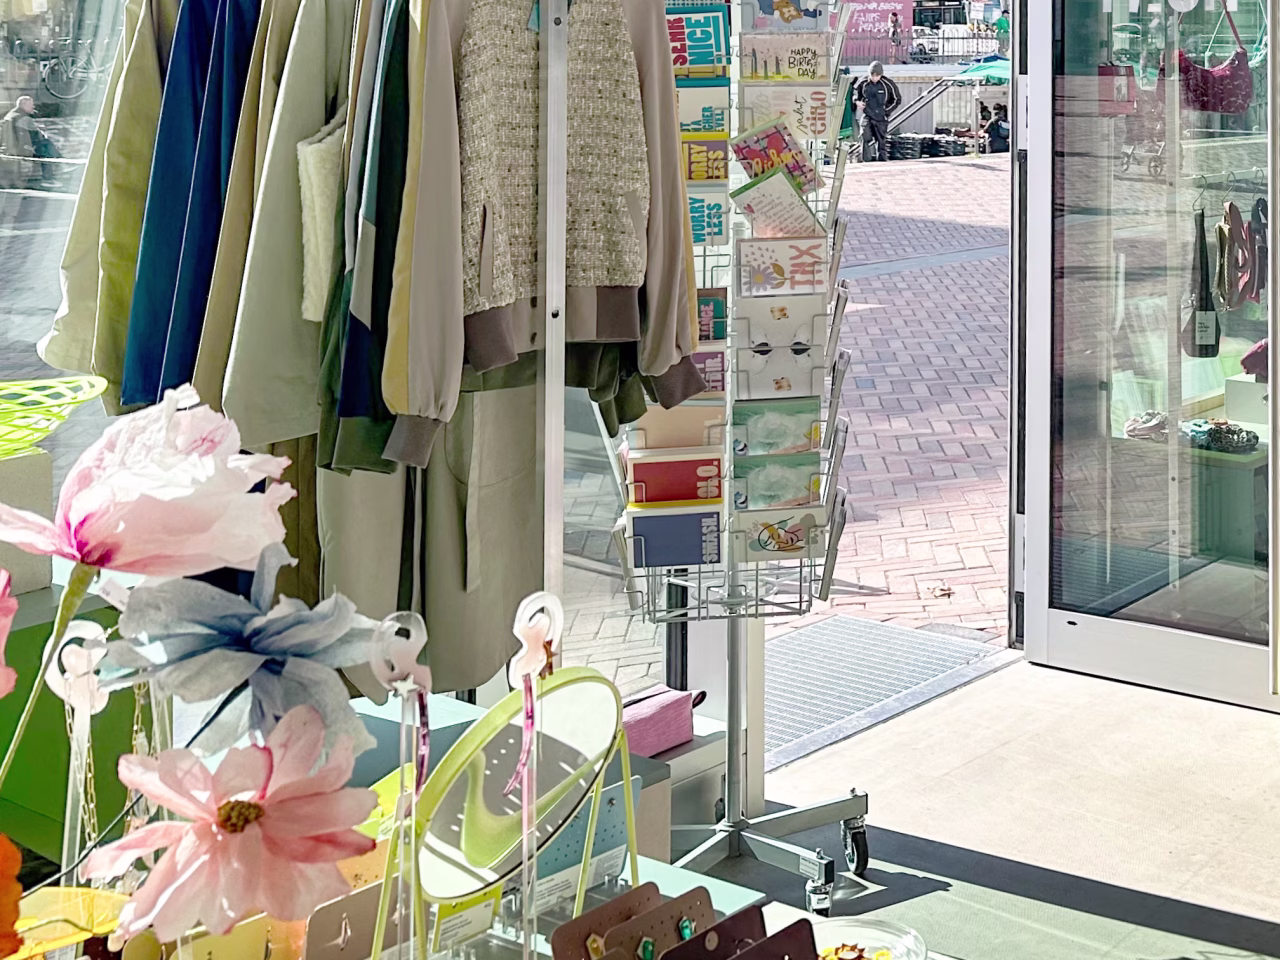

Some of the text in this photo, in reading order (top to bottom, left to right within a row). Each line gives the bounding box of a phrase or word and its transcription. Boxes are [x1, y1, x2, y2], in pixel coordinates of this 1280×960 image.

[797, 68, 816, 79] DAY
[688, 196, 706, 244] WORRY
[706, 202, 723, 237] LESS
[788, 243, 824, 290] THX
